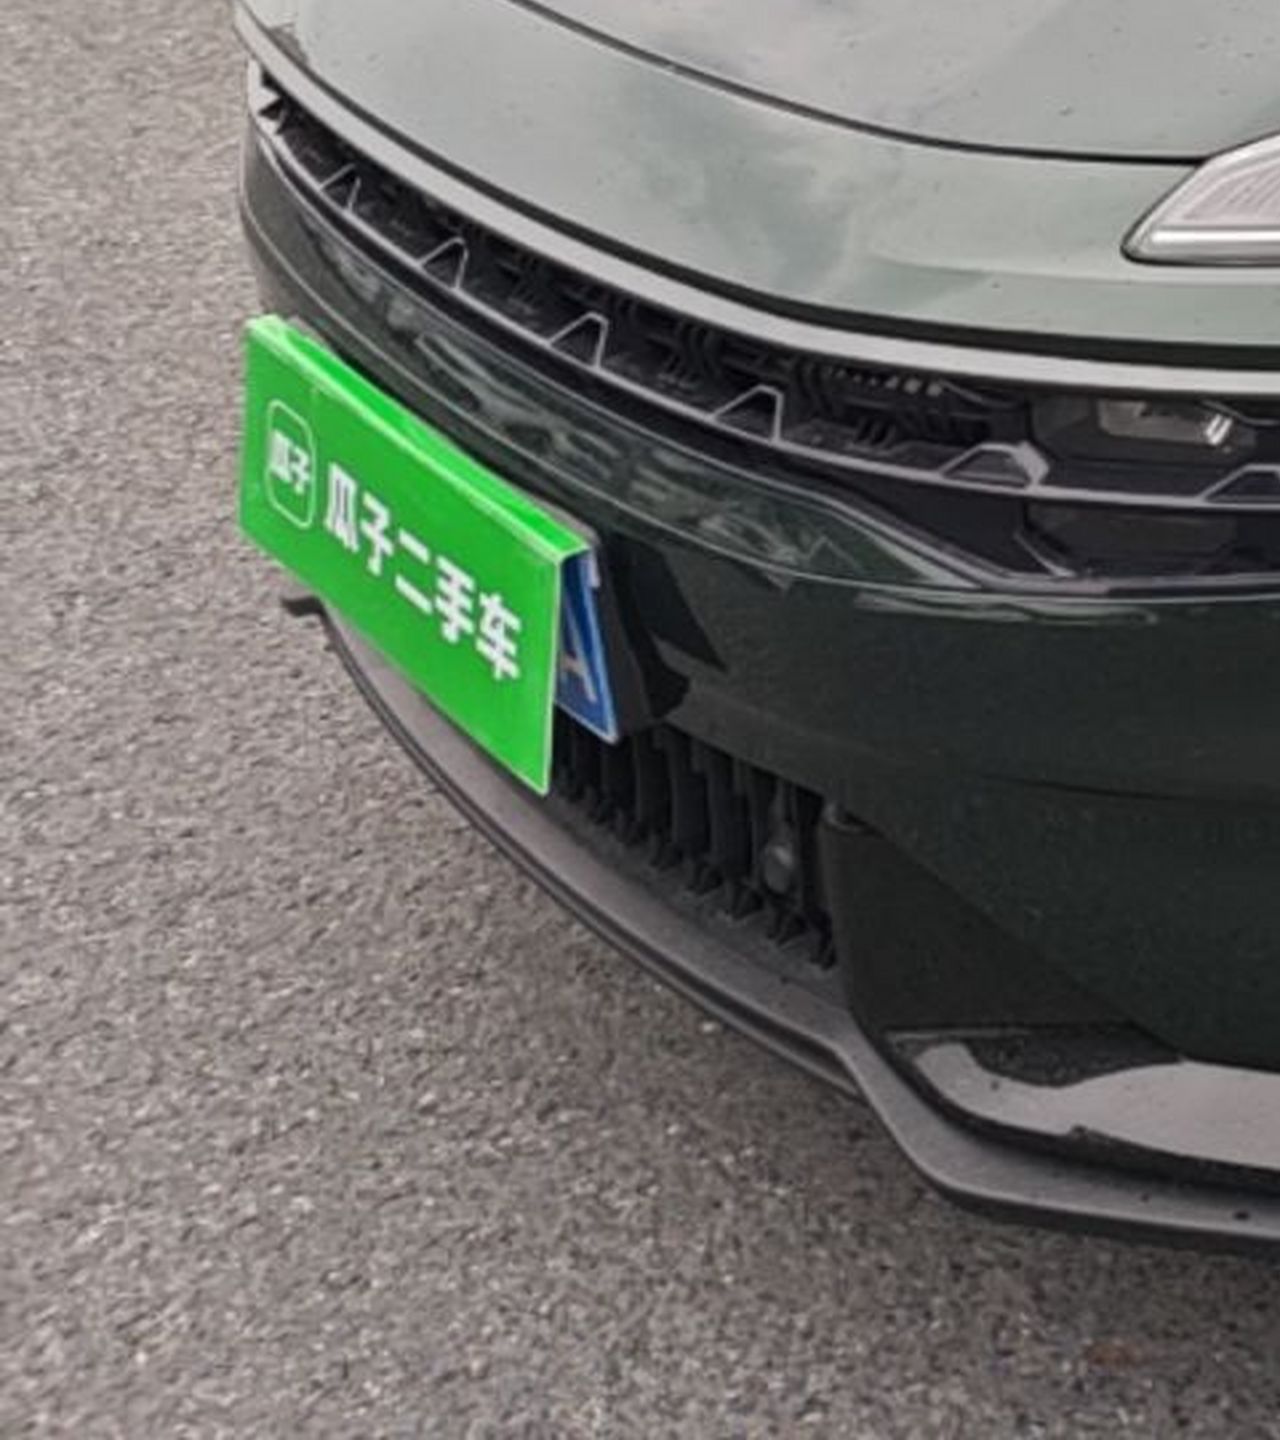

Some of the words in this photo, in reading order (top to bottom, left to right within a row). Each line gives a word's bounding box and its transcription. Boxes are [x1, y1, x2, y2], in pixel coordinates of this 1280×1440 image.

[324, 462, 522, 681] 瓜子二手车
